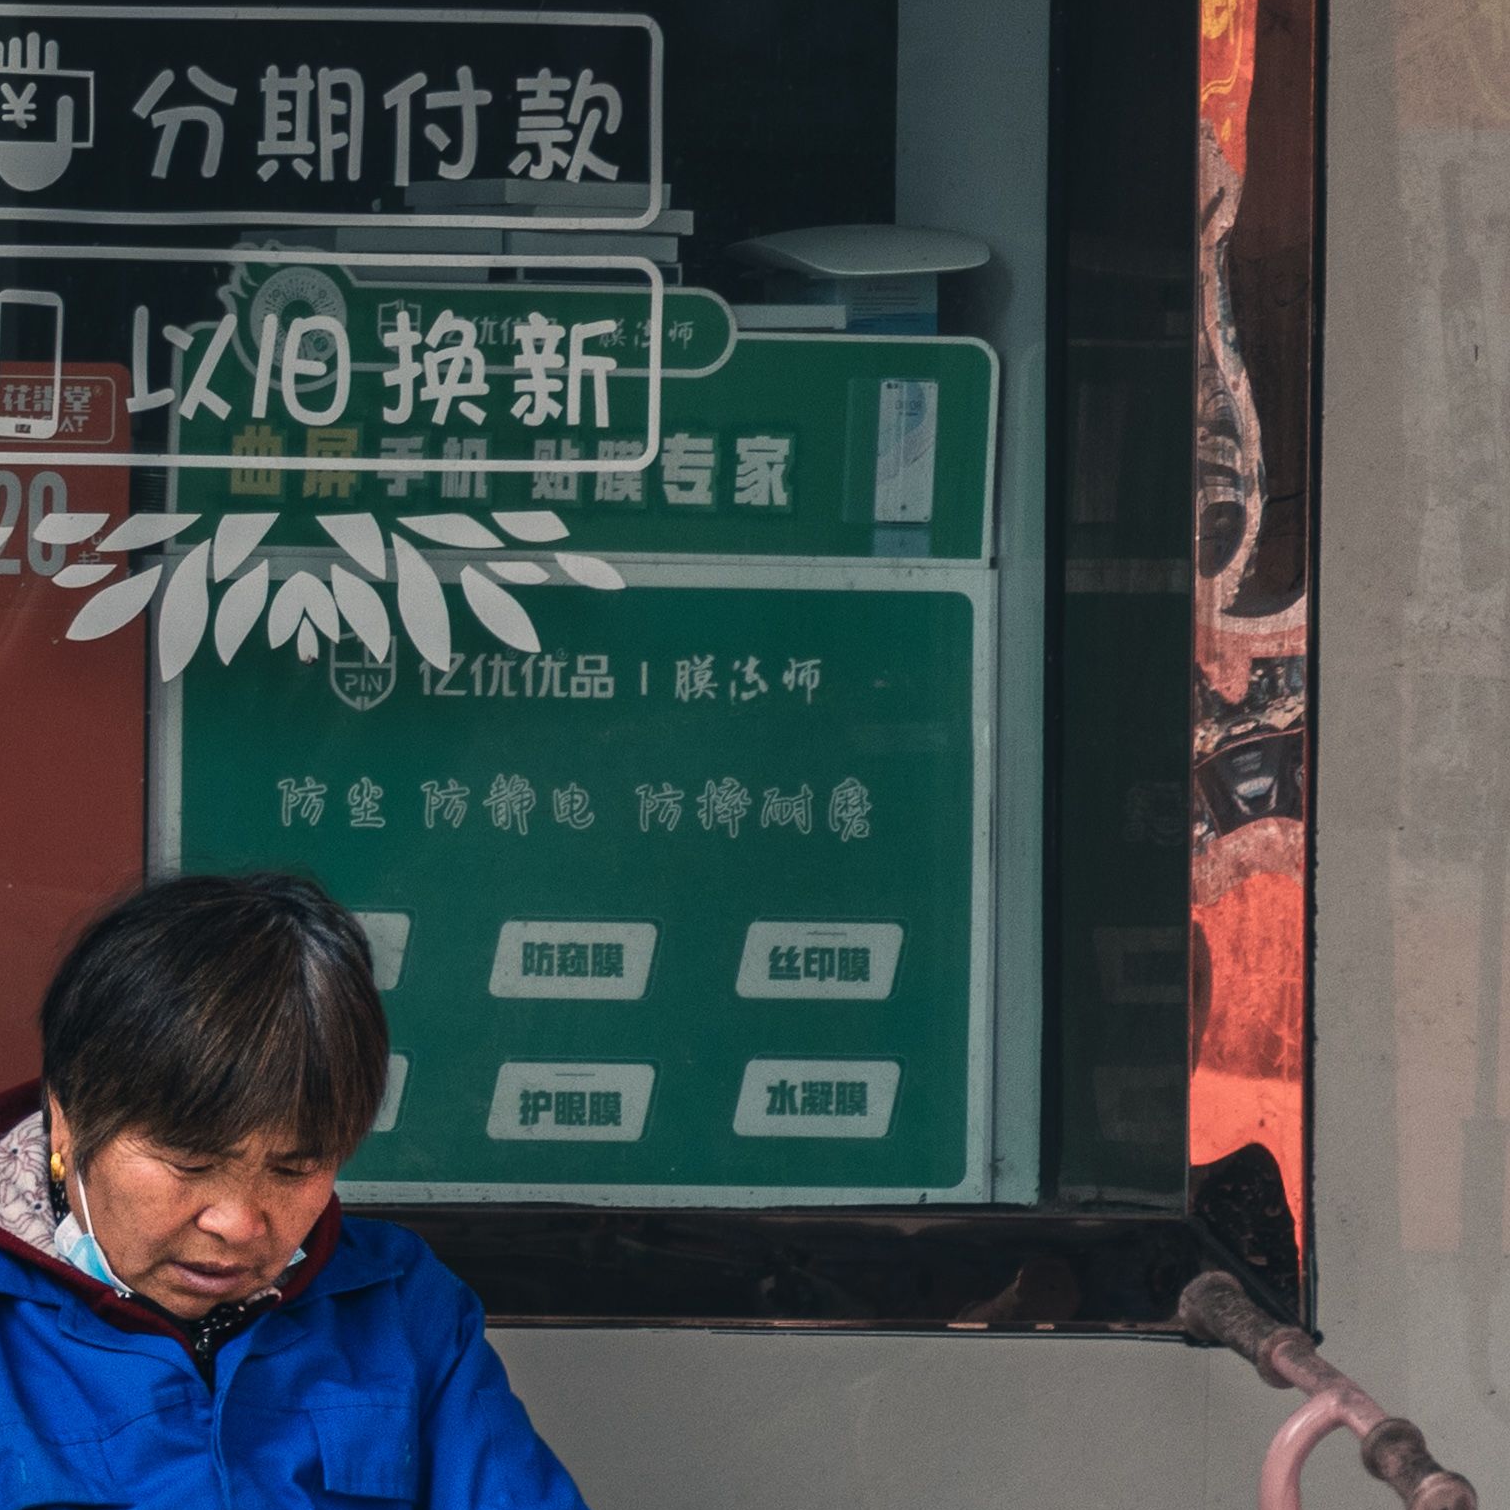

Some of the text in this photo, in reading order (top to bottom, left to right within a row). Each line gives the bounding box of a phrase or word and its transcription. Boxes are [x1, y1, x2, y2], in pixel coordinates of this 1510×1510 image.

[132, 64, 624, 186] 分期付款
[127, 305, 620, 430] 以旧换新
[522, 941, 625, 979] 防窥膜
[767, 946, 870, 983] 丝印膜
[518, 1089, 622, 1127] 护眼膜
[765, 1081, 868, 1117] 水凝膜
